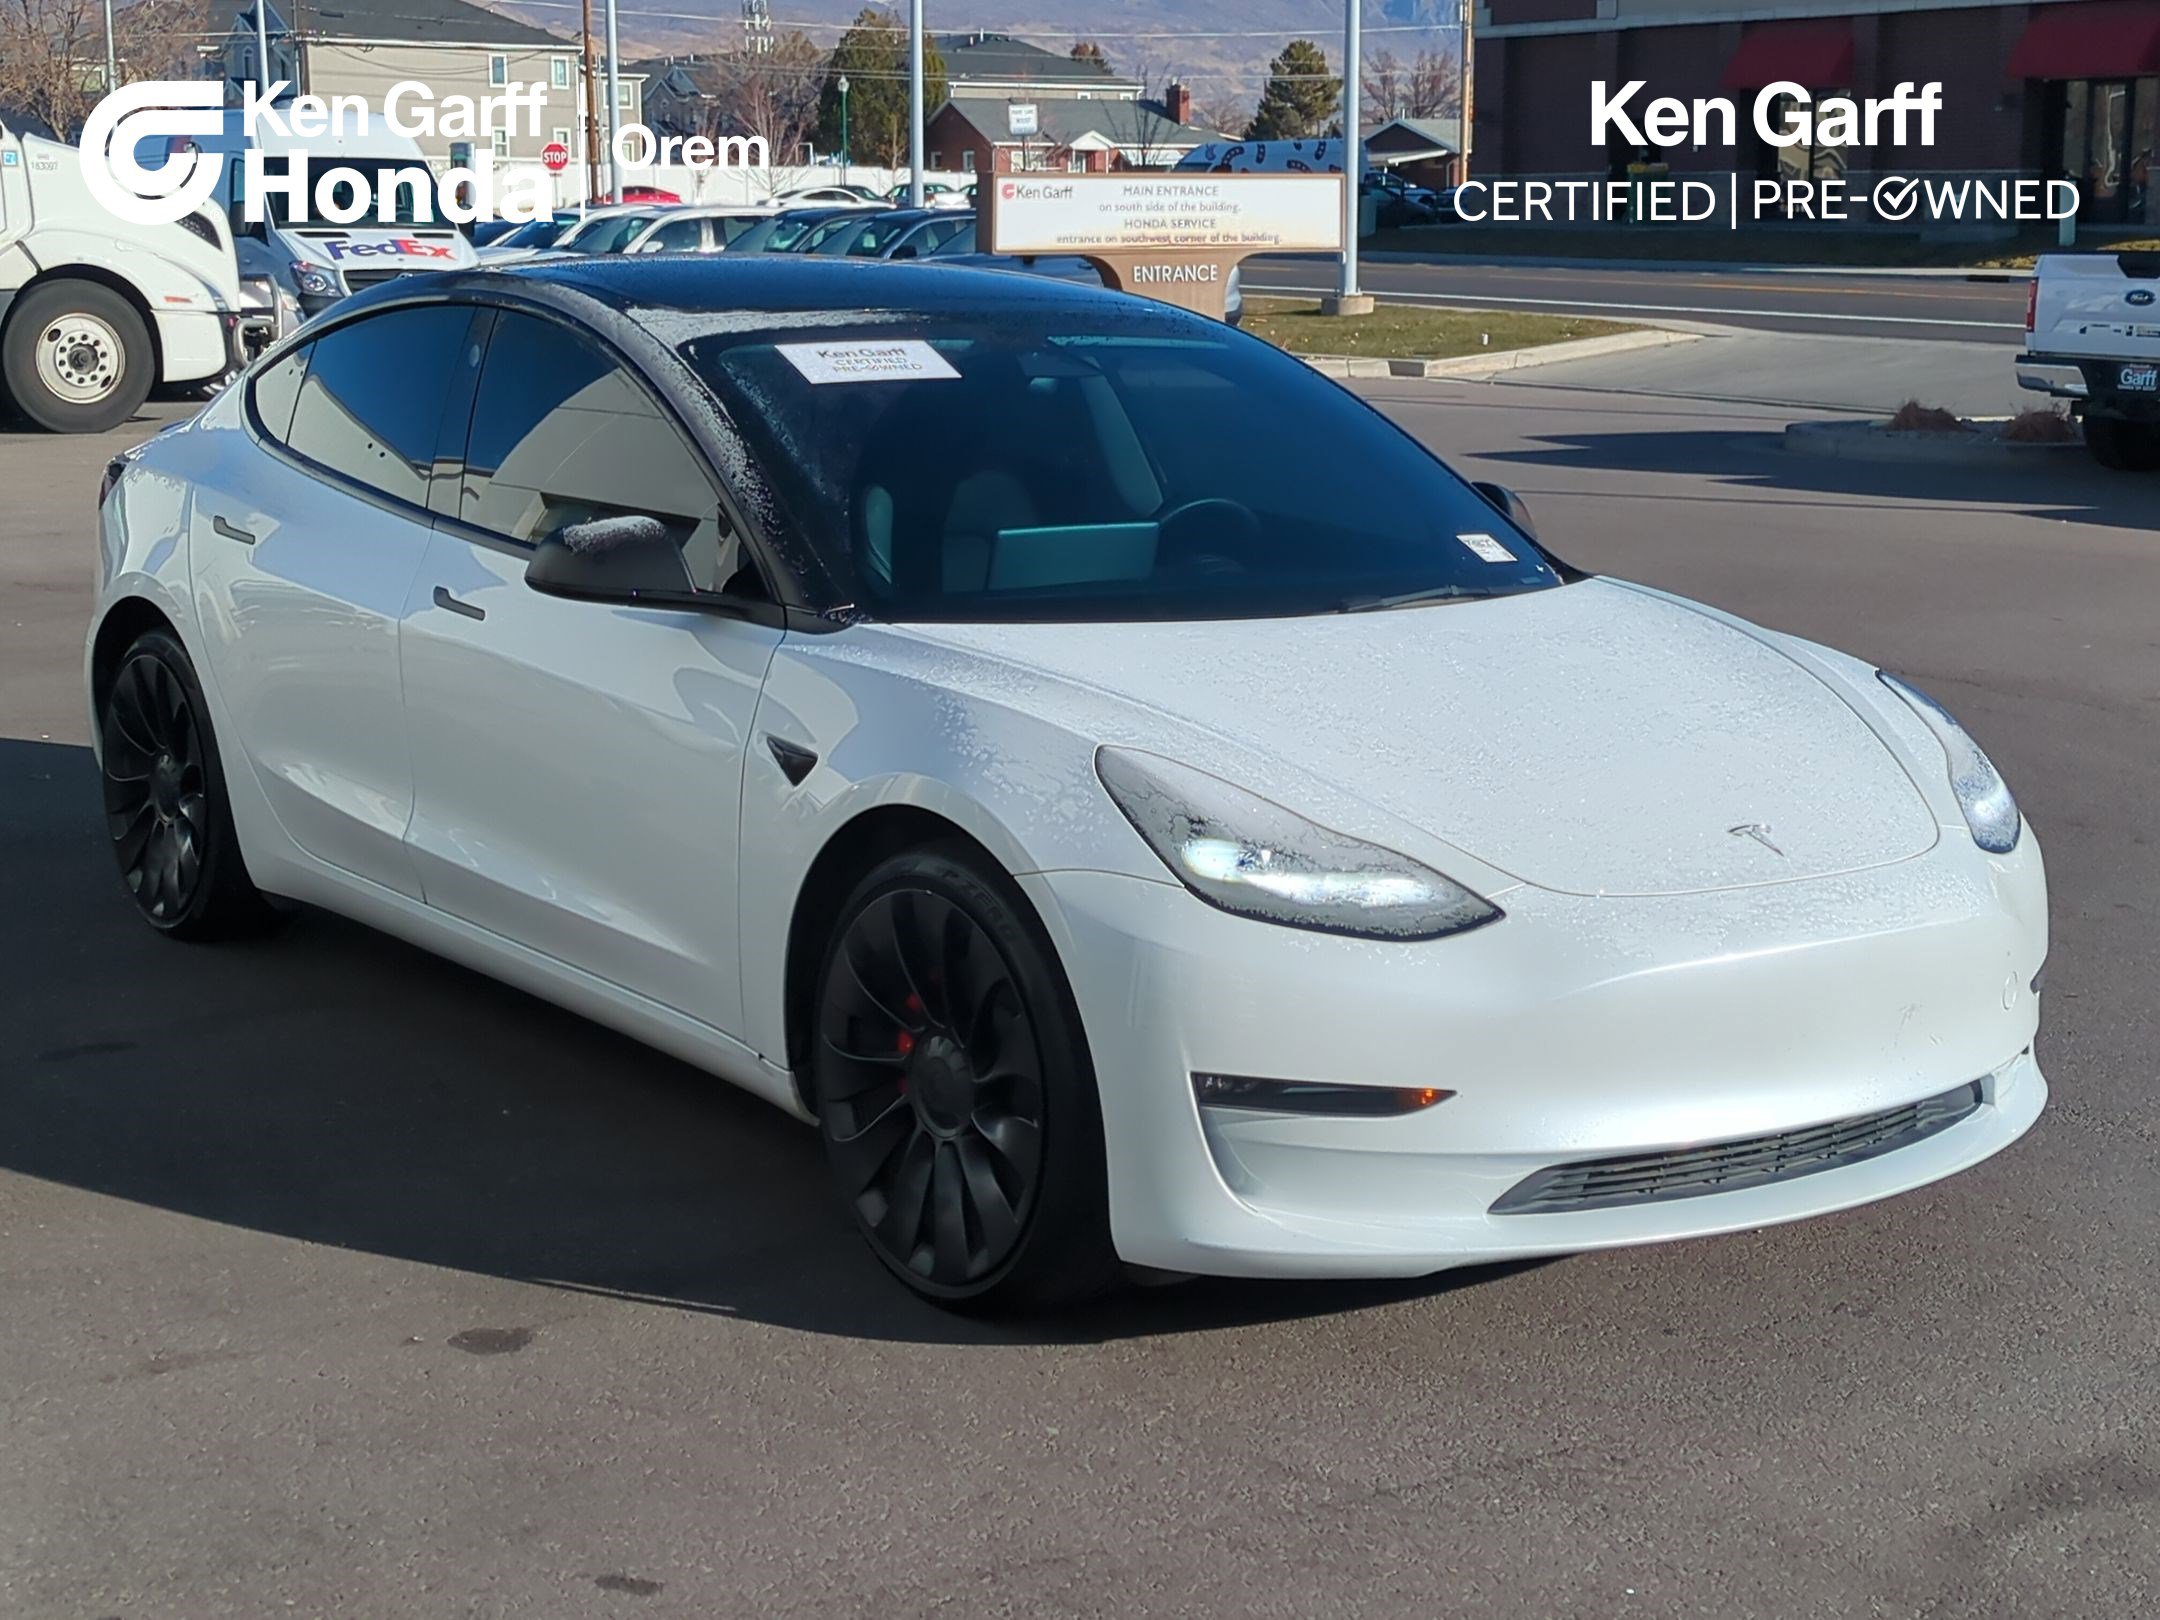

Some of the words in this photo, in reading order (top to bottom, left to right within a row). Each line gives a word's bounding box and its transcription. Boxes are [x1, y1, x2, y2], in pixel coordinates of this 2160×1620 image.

[543, 151, 567, 163] STOP
[1016, 185, 1040, 199] Ken
[1042, 185, 1073, 200] Garff
[1123, 186, 1154, 197] MAIN
[1156, 186, 1220, 197] ENTRANCE
[1099, 204, 1112, 212] on
[1114, 201, 1142, 212] south
[1146, 201, 1165, 212] side
[1168, 201, 1179, 212] of
[1181, 201, 1196, 212] the
[1200, 201, 1242, 214] building.
[1124, 218, 1168, 229] HONDA
[1171, 218, 1217, 229] SERVICE
[1056, 235, 1102, 244] entrance
[1105, 236, 1118, 244] on
[1120, 234, 1171, 244] southwest
[1174, 234, 1207, 243] corner
[1210, 233, 1221, 243] of
[1223, 233, 1239, 243] the
[1241, 232, 1283, 246] building.
[324, 239, 458, 261] FedEx
[1133, 264, 1218, 283] ENTRANCE
[816, 349, 858, 358] Ken
[835, 356, 909, 366] CERTIFIED
[2120, 367, 2158, 387] Garff
